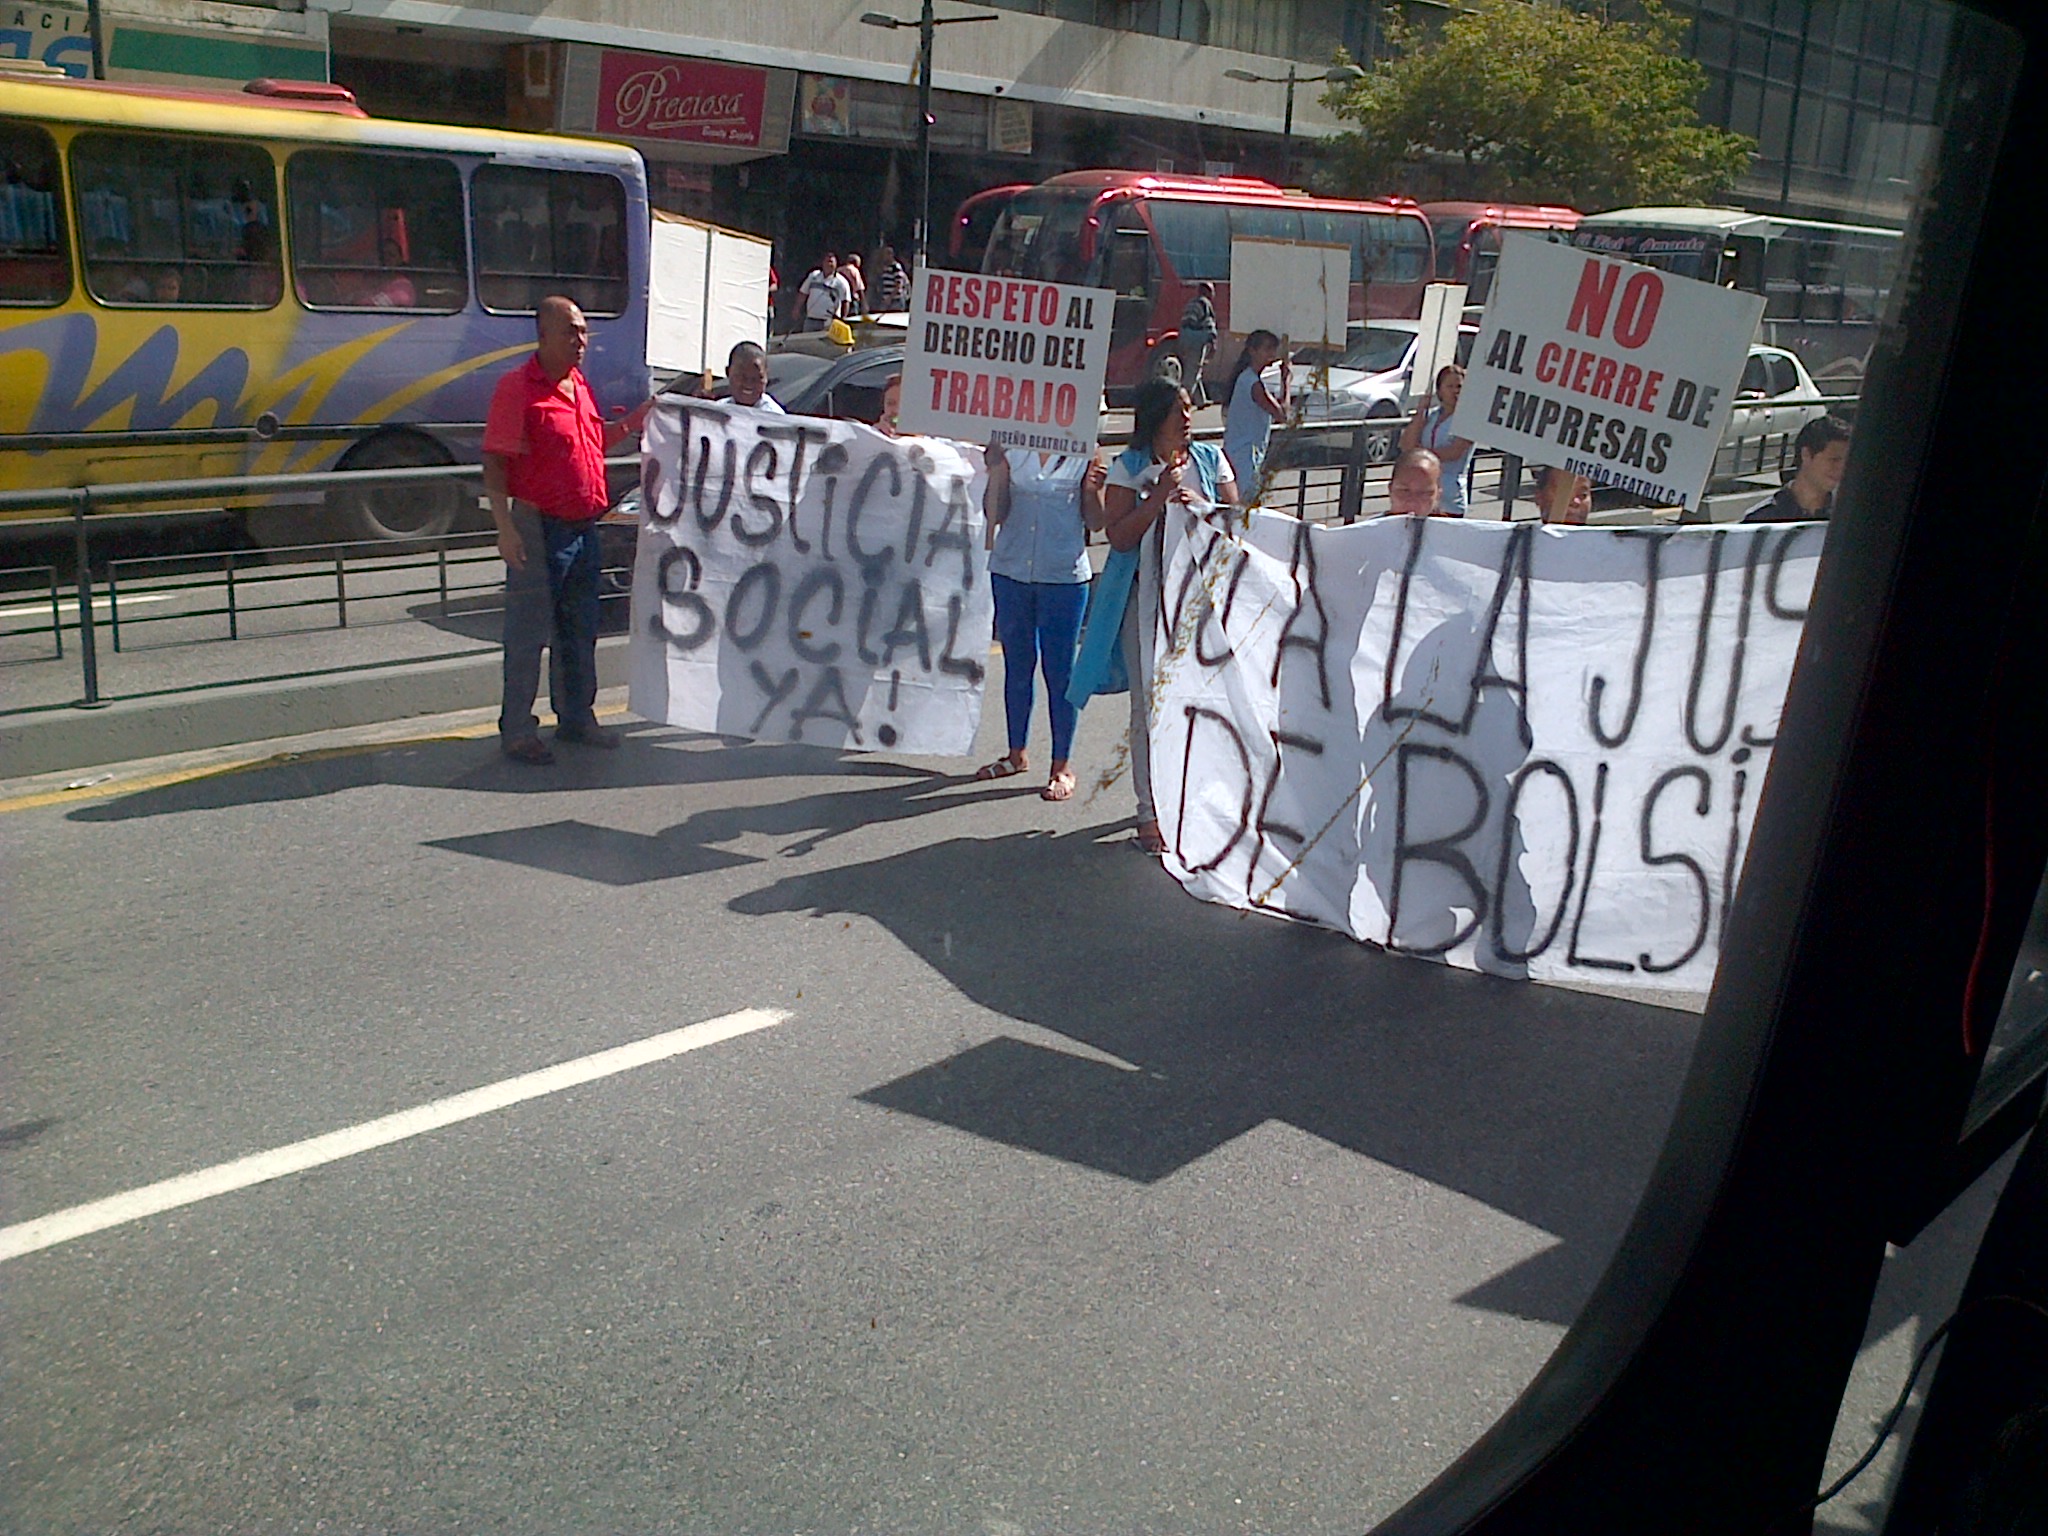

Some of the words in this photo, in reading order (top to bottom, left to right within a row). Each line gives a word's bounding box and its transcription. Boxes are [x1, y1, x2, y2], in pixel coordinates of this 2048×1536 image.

[615, 65, 743, 128] Preciosa
[925, 274, 1060, 327] RESPETO
[1065, 296, 1094, 330] AL
[1566, 258, 1664, 349] NO
[924, 321, 1036, 365] DERECHO
[1043, 335, 1086, 370] DEL
[1486, 329, 1528, 375] AL
[1535, 342, 1665, 413] CIERRE
[1666, 378, 1720, 429] DE
[930, 368, 1077, 428] TRABAJO
[1488, 385, 1673, 474] EMPRESAS
[991, 430, 1026, 446] DISEÑO
[1029, 435, 1069, 452] BEATRIZ
[1564, 458, 1610, 485] DISEÑO
[650, 546, 985, 685] SOCIAL
[1384, 516, 1533, 749] LA
[1176, 705, 1325, 923] DE
